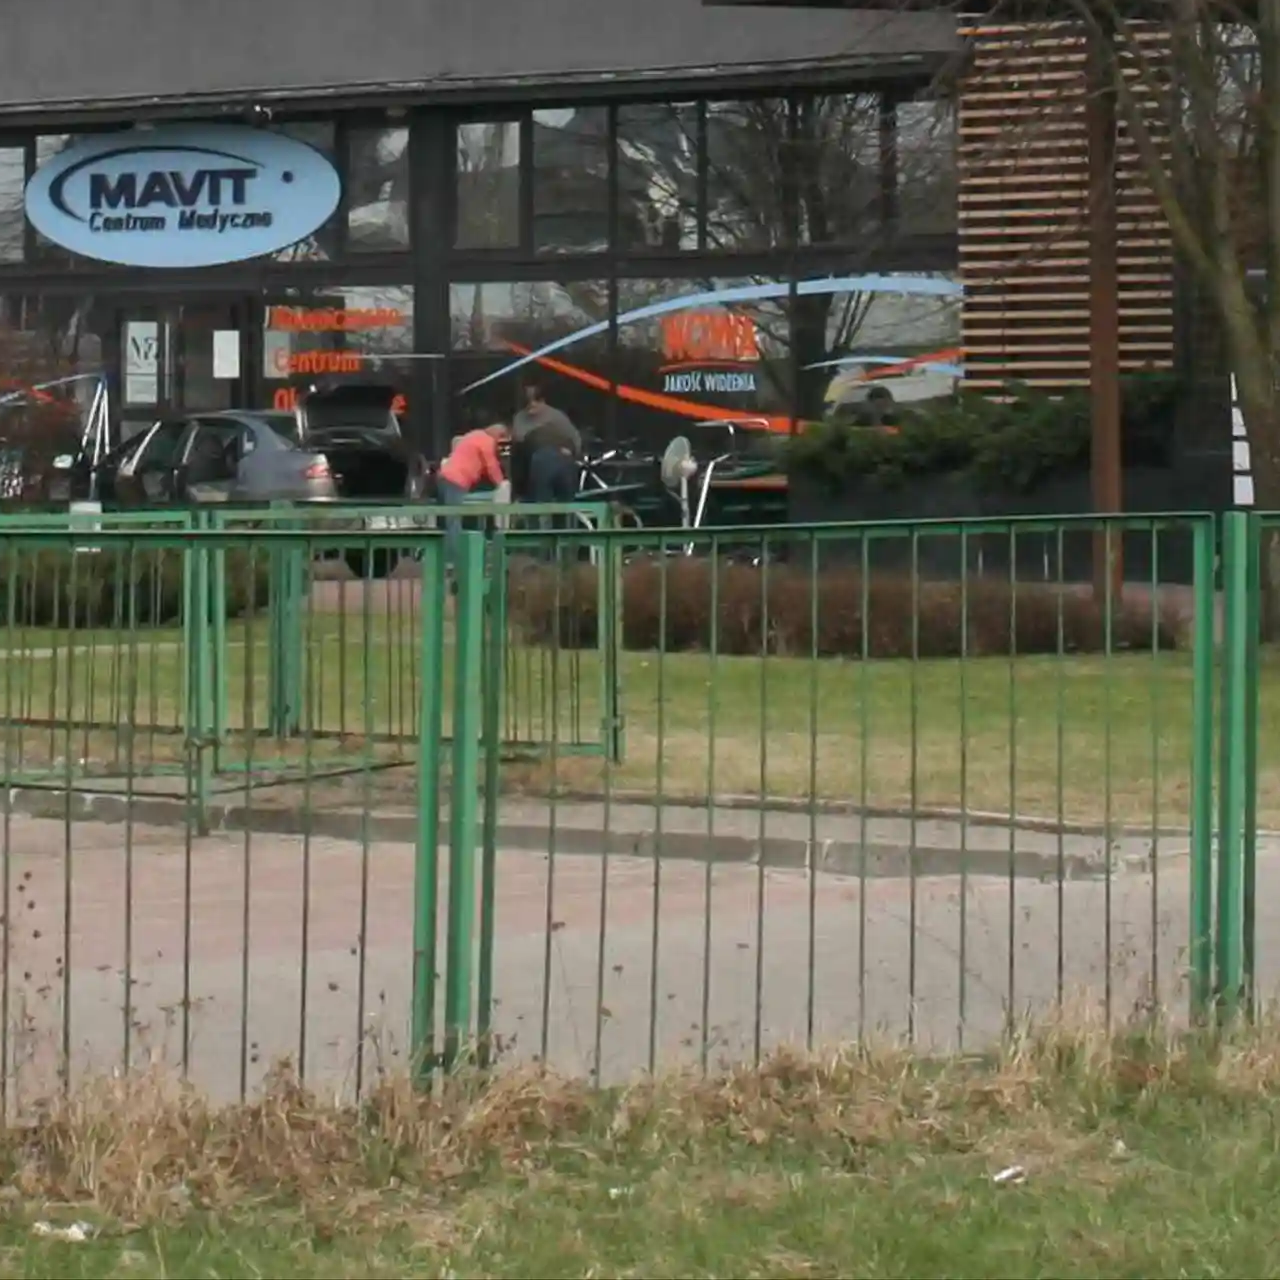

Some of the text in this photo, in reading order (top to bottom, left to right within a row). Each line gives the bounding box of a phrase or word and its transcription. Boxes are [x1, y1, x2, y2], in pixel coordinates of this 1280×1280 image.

[89, 167, 258, 210] MAVIT
[89, 211, 167, 233] Centrum
[274, 348, 363, 374] Centrum
